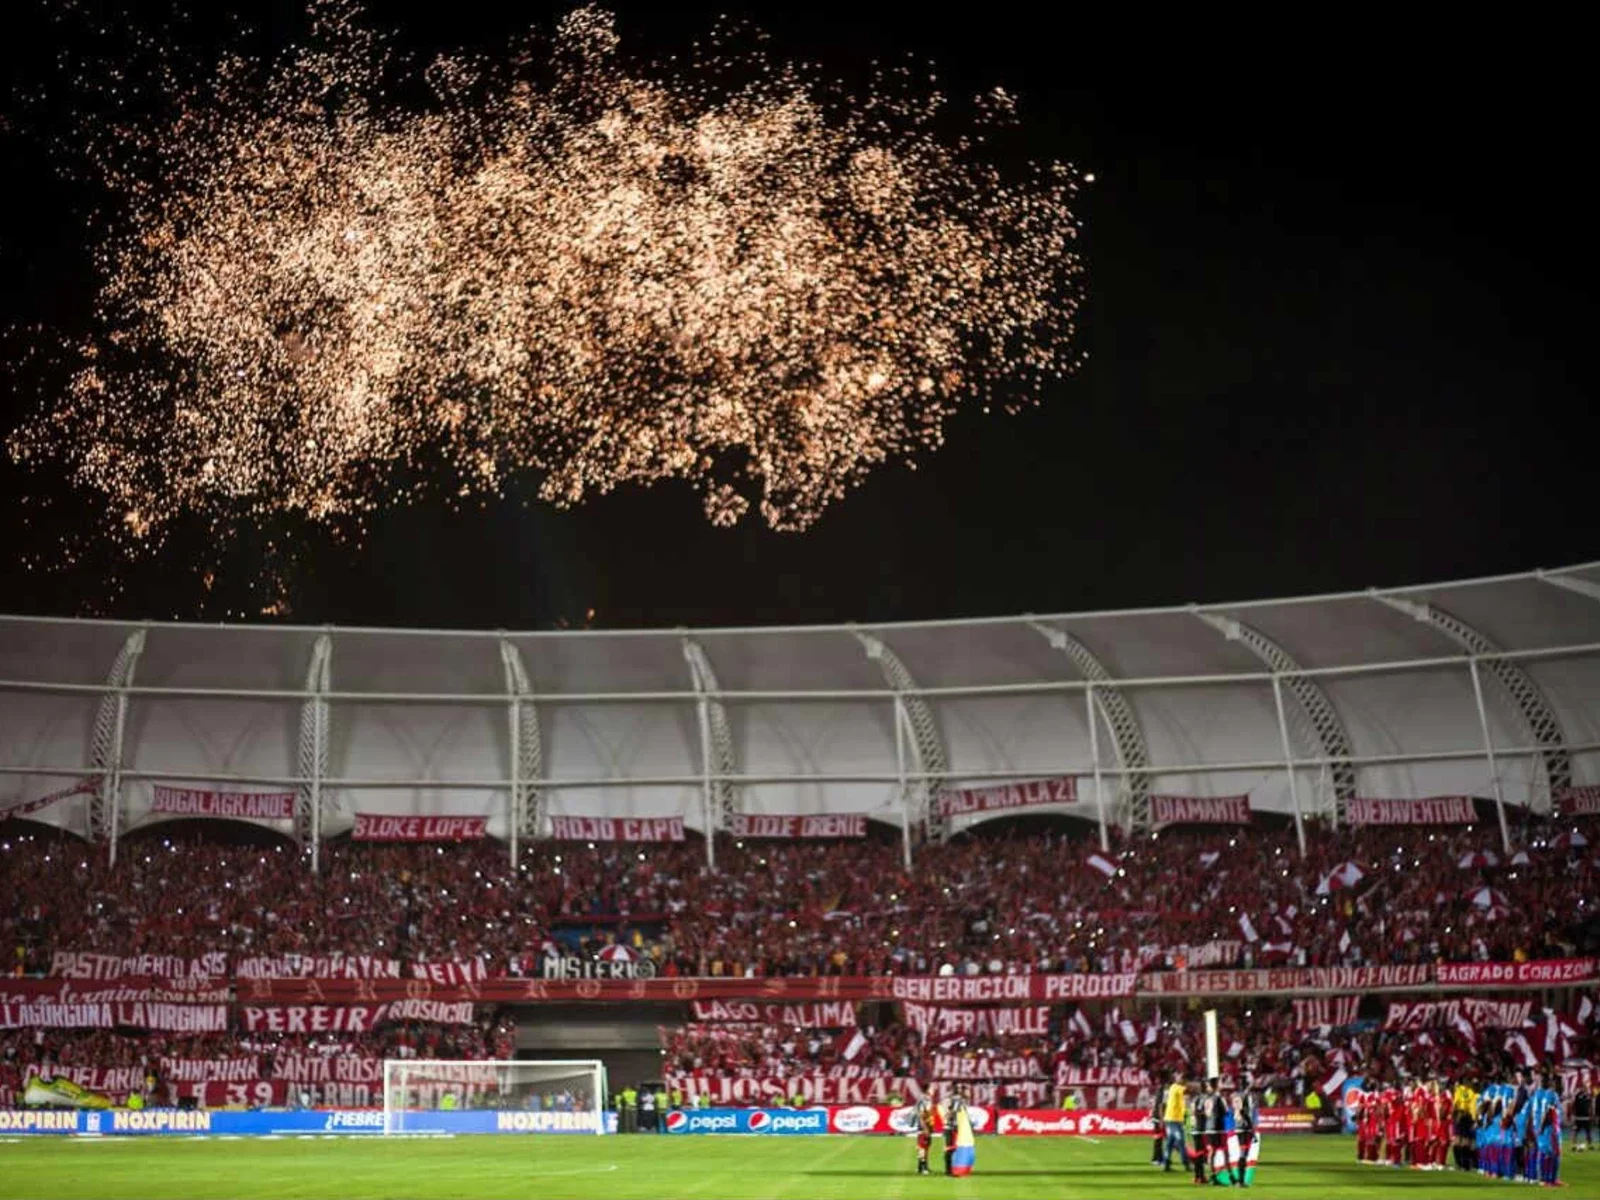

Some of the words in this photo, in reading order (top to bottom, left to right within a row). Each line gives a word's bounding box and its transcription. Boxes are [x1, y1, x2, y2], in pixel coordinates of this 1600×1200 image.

[51, 952, 121, 980] PASTO
[1437, 963, 1514, 981] SAGRADO
[147, 1004, 228, 1031] VIRGINIA
[113, 1112, 210, 1129] NOXPIRIN
[689, 1116, 737, 1130] pepsi
[772, 1115, 820, 1130] pepsi
